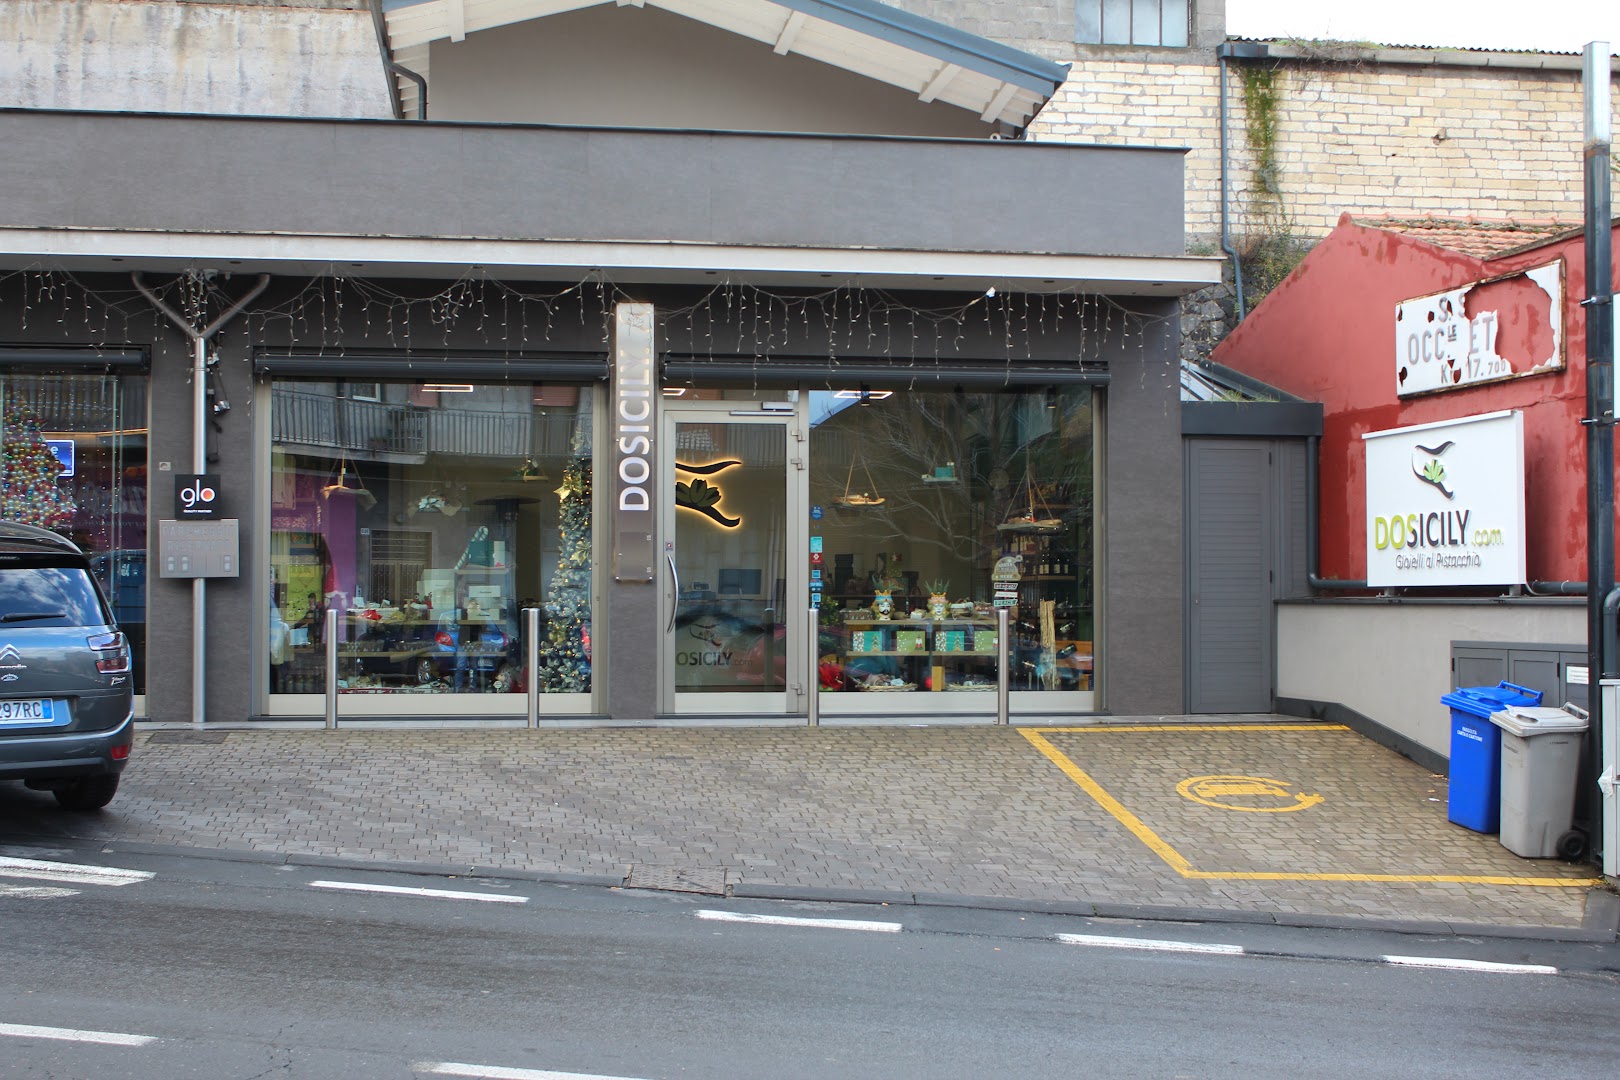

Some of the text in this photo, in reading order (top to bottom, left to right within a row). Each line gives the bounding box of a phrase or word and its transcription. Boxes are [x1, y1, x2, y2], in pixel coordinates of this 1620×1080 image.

[1469, 316, 1494, 355] ET
[180, 478, 215, 507] glo
[1395, 553, 1424, 570] Gioielli
[1436, 551, 1481, 568] Pistacchio
